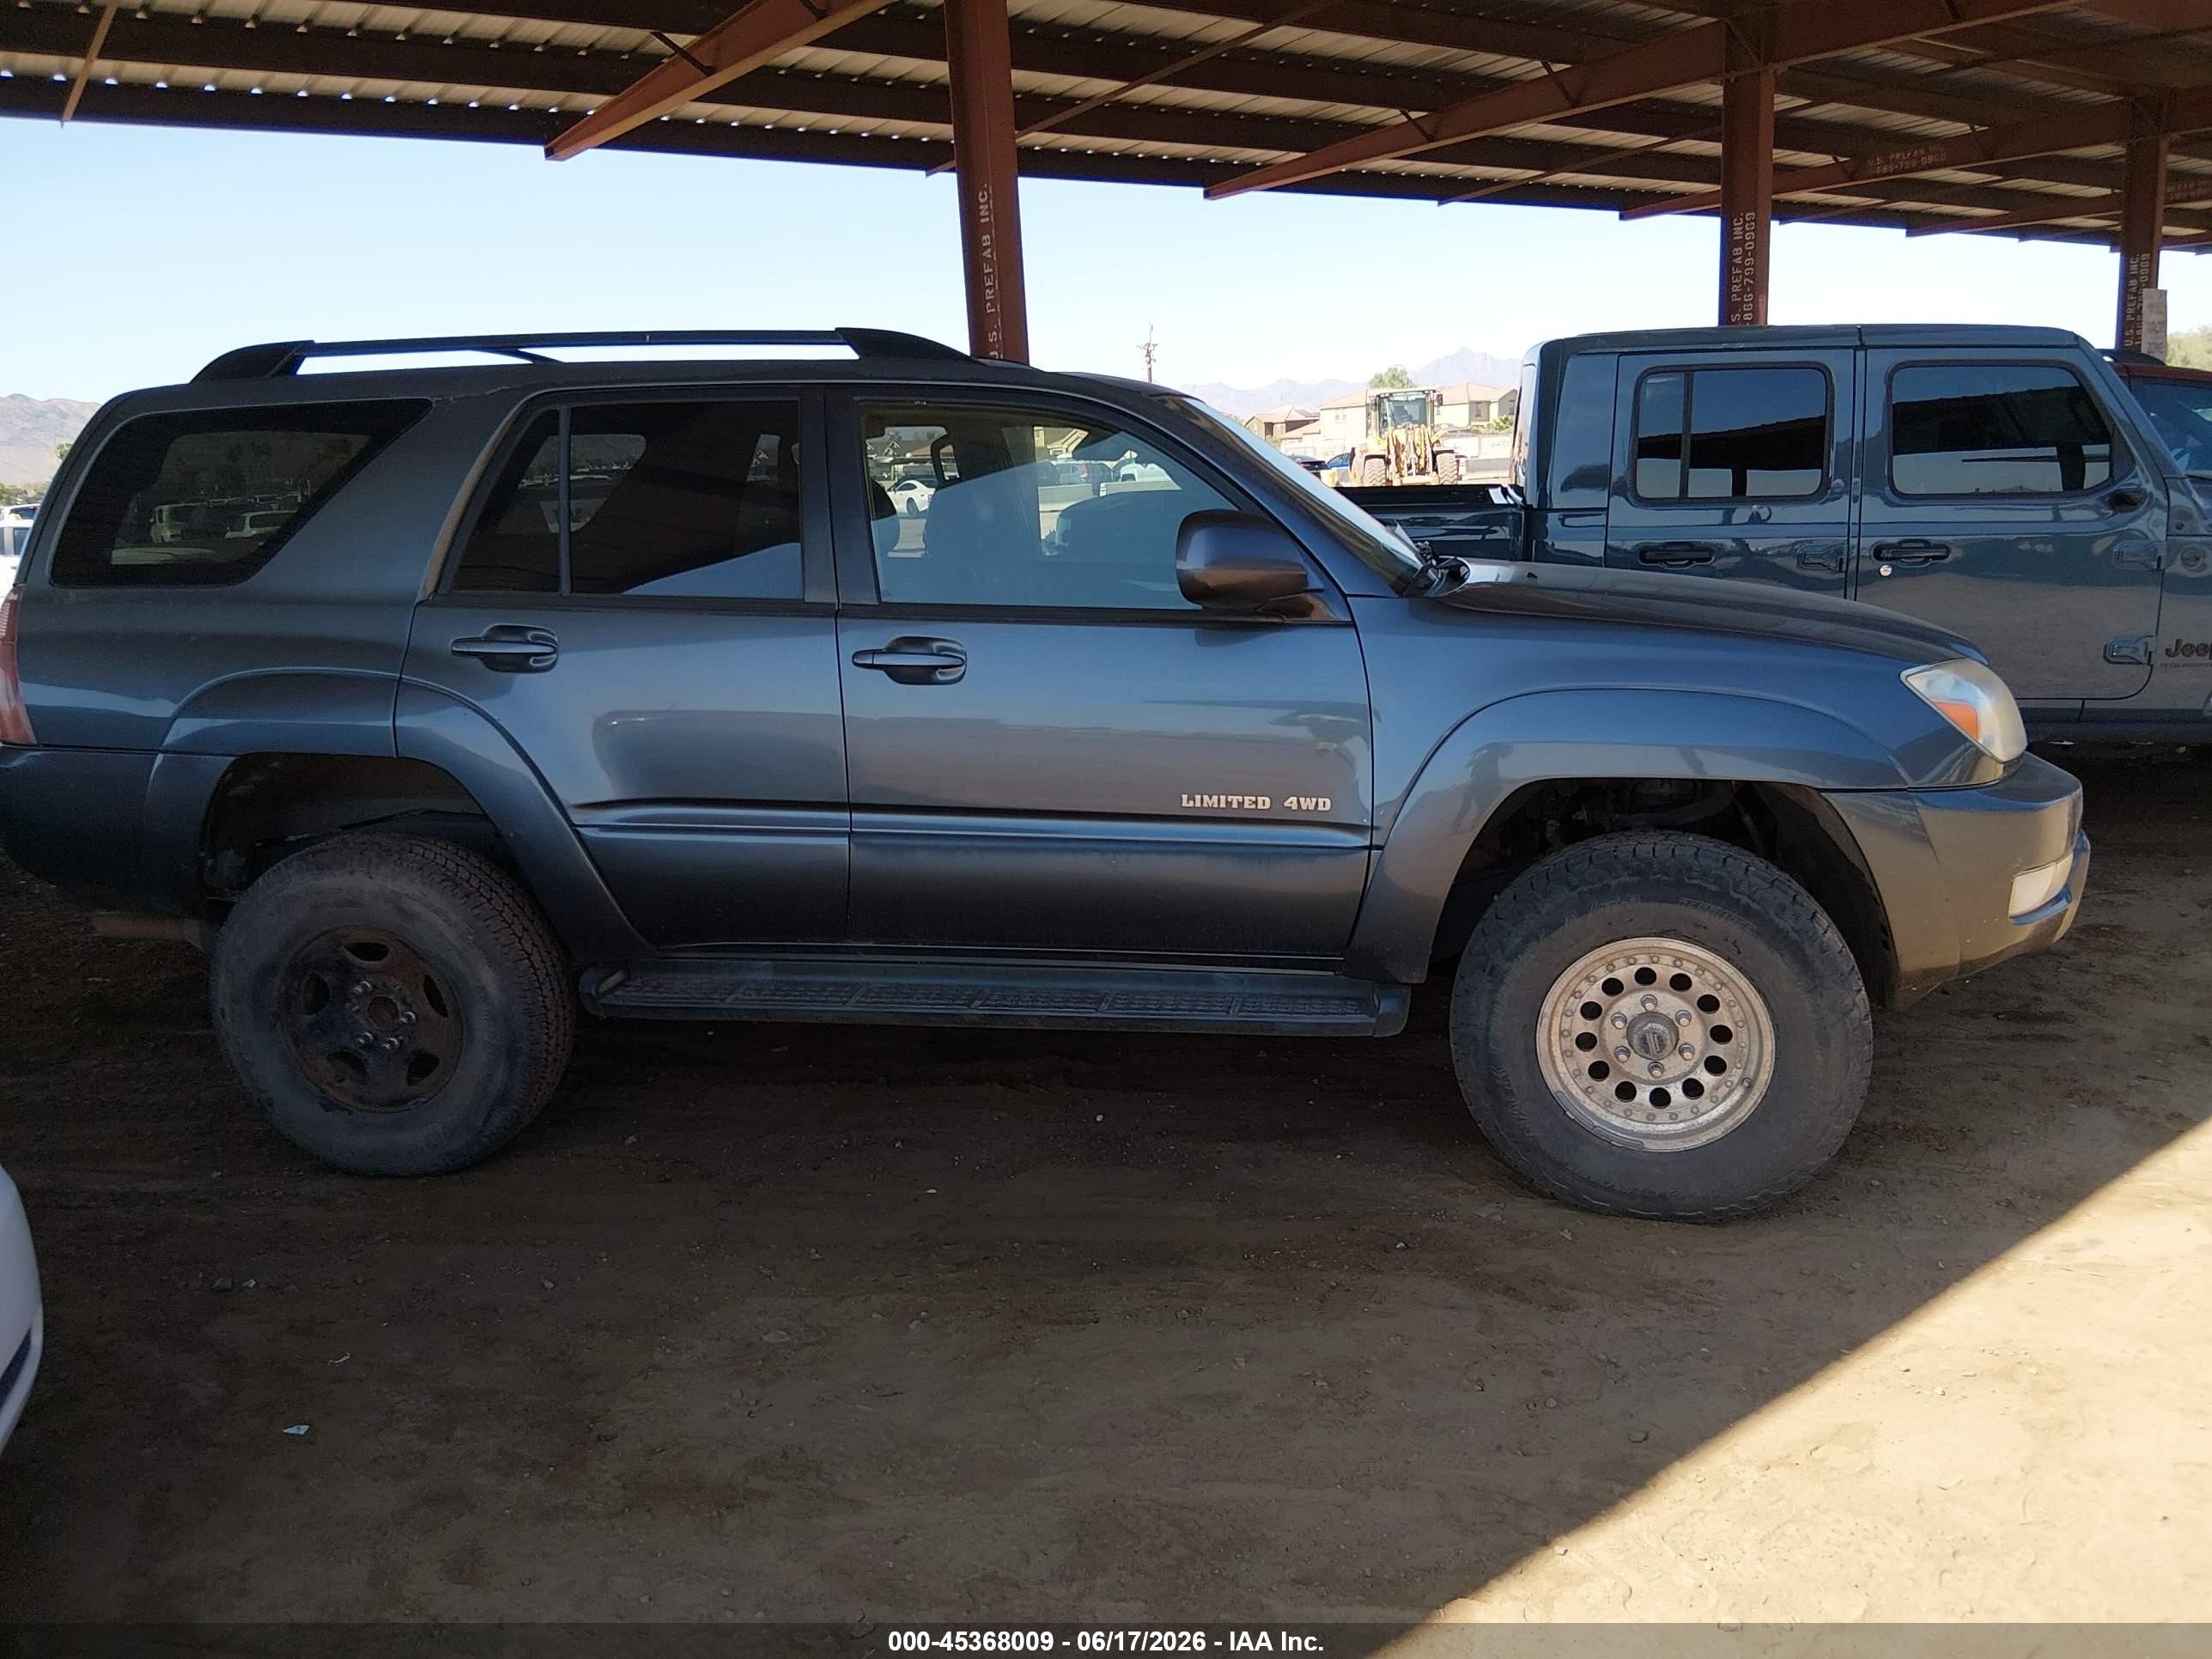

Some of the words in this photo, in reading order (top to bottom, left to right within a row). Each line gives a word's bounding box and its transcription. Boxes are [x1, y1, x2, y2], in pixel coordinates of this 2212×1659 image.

[978, 183, 989, 223] INC.
[1733, 212, 1744, 240] INC.
[981, 234, 996, 313] PREFAB
[1731, 246, 1743, 302] PREFAB
[1742, 212, 1756, 325] -866-799-0969
[1730, 308, 1741, 322] S.
[2125, 278, 2138, 322] PREFAB
[2165, 638, 2212, 660] Jee
[1181, 793, 1272, 811] LIMITED
[1283, 796, 1332, 811] 4WD
